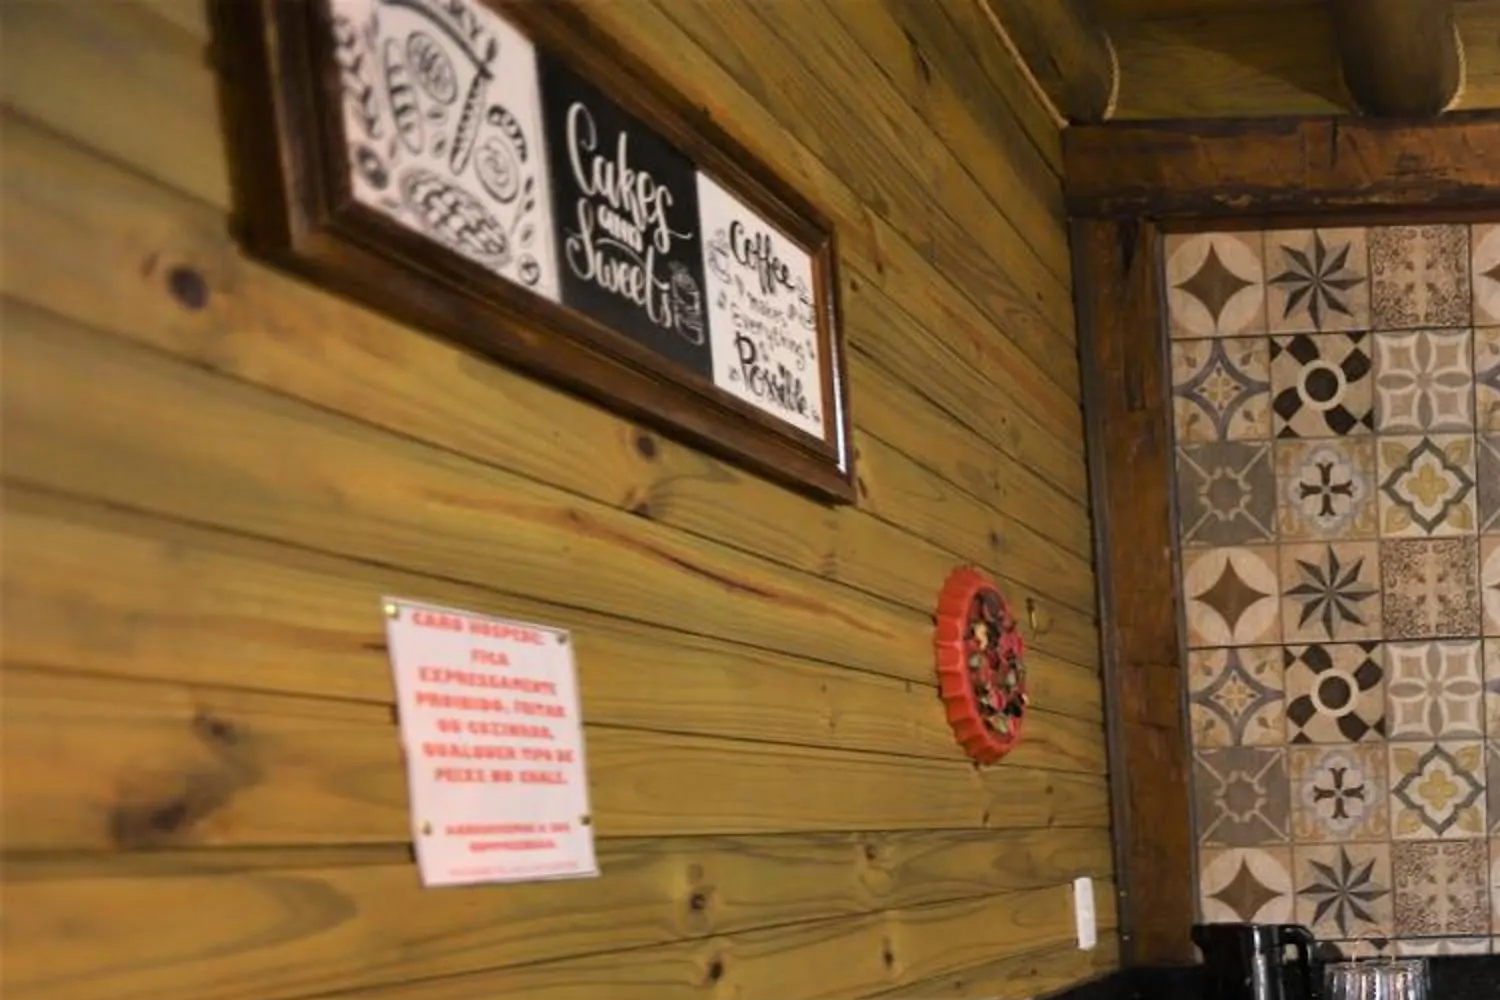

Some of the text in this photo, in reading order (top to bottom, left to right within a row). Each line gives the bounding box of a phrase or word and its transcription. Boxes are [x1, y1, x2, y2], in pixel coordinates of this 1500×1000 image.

[566, 102, 693, 254] Cakes
[565, 197, 672, 328] Sweets
[730, 220, 795, 294] Coffee
